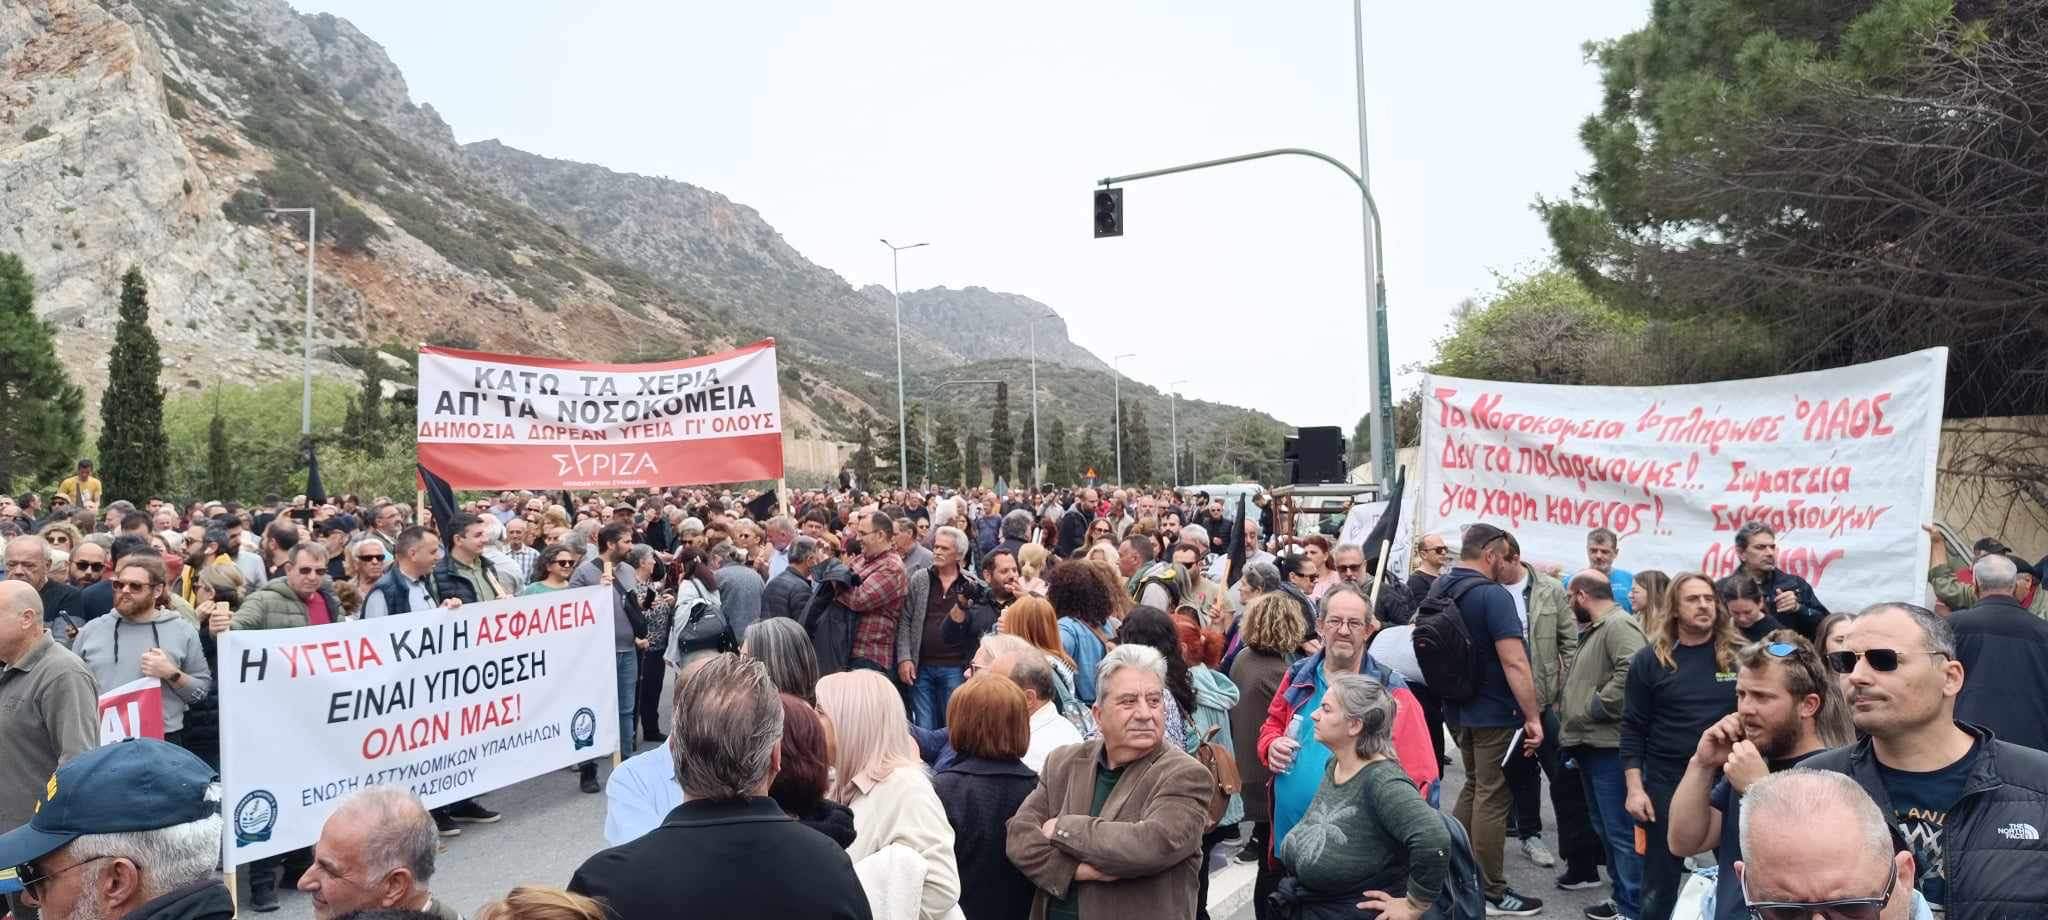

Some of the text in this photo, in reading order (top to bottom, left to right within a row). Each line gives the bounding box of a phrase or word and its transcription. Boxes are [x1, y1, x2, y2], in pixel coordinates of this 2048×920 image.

[435, 384, 755, 423] ΑΠ' ΤΑ ΝΟΣΟΚΟΜΕΙΑ
[475, 367, 720, 396] ΚΑΤΩ ΤΑ ΧΕΡΙΑ
[419, 413, 774, 441] ΔΗΜΟΣΙΑ ΔΩΡΕΑΝ ΥΓΕΙΑ ΓΙ' ΟΛΟΥΣ
[1803, 392, 1894, 440] ΛΑΟΣ
[552, 445, 658, 477] ΣΥΡΙΖΑ
[1725, 449, 1852, 502] Σωματεία
[240, 600, 595, 683] Η ΥΓΕΙΑ ΚΑΙ Η ΑΣΦΑΛΕΙΑ
[327, 650, 546, 723] ΕΙΝΑΙ ΥΠΟΘΕΣΗ
[361, 712, 449, 760] ΟΛΩΝ
[460, 694, 522, 737] ΜΑΣ!
[302, 774, 361, 806] ΕΝΩΣΗ
[365, 745, 478, 787] ΑΣΤΥΝΟΜΙΚΩΝ
[482, 723, 560, 757] ΥΠΑΛΛΗΛΩΝ
